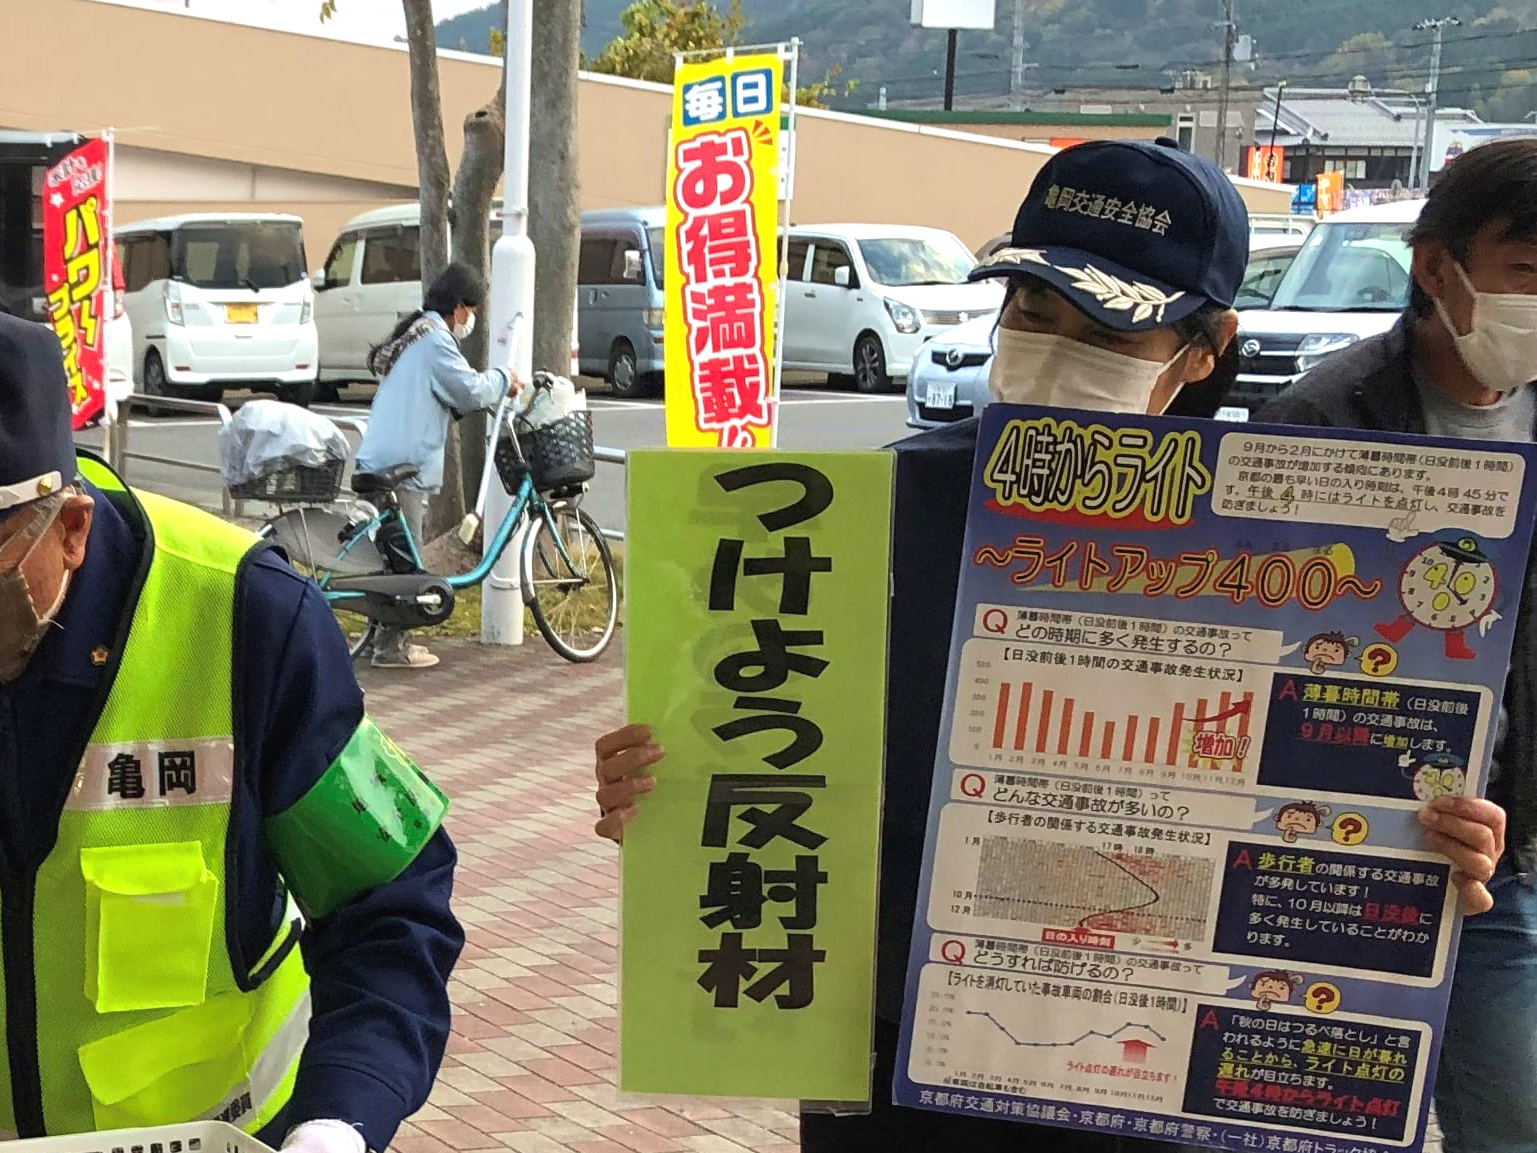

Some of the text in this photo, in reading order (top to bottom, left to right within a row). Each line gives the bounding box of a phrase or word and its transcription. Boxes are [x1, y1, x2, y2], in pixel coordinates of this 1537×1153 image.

[682, 69, 773, 123] 毎日
[1044, 184, 1172, 236] 亀岡交通安全協会
[988, 420, 1208, 522] 4時からライト
[982, 608, 1008, 635] Q
[1015, 623, 1232, 658] どの時期に多く発生するの？
[1279, 679, 1297, 701] A
[696, 461, 834, 1011] つけよう反射材
[1194, 731, 1250, 760] 増加！
[107, 750, 196, 799] 亀岡
[960, 773, 986, 798] Q
[993, 788, 1189, 821] どんな交通事故が多いの？
[987, 810, 1211, 845] 【歩行者の関係する交通事故発生状況】
[1233, 849, 1252, 870] A
[1258, 852, 1439, 888] 歩行者の関係する交通事故
[1254, 875, 1369, 898] が多発しています！
[1246, 931, 1290, 947] ります。
[1248, 912, 1429, 944] 多く発生していることがわか
[941, 939, 966, 966] Q
[973, 948, 1134, 981] どうすれば防げるの？
[1200, 1010, 1219, 1031] A
[1220, 1047, 1405, 1082] ることから、ライト点灯の
